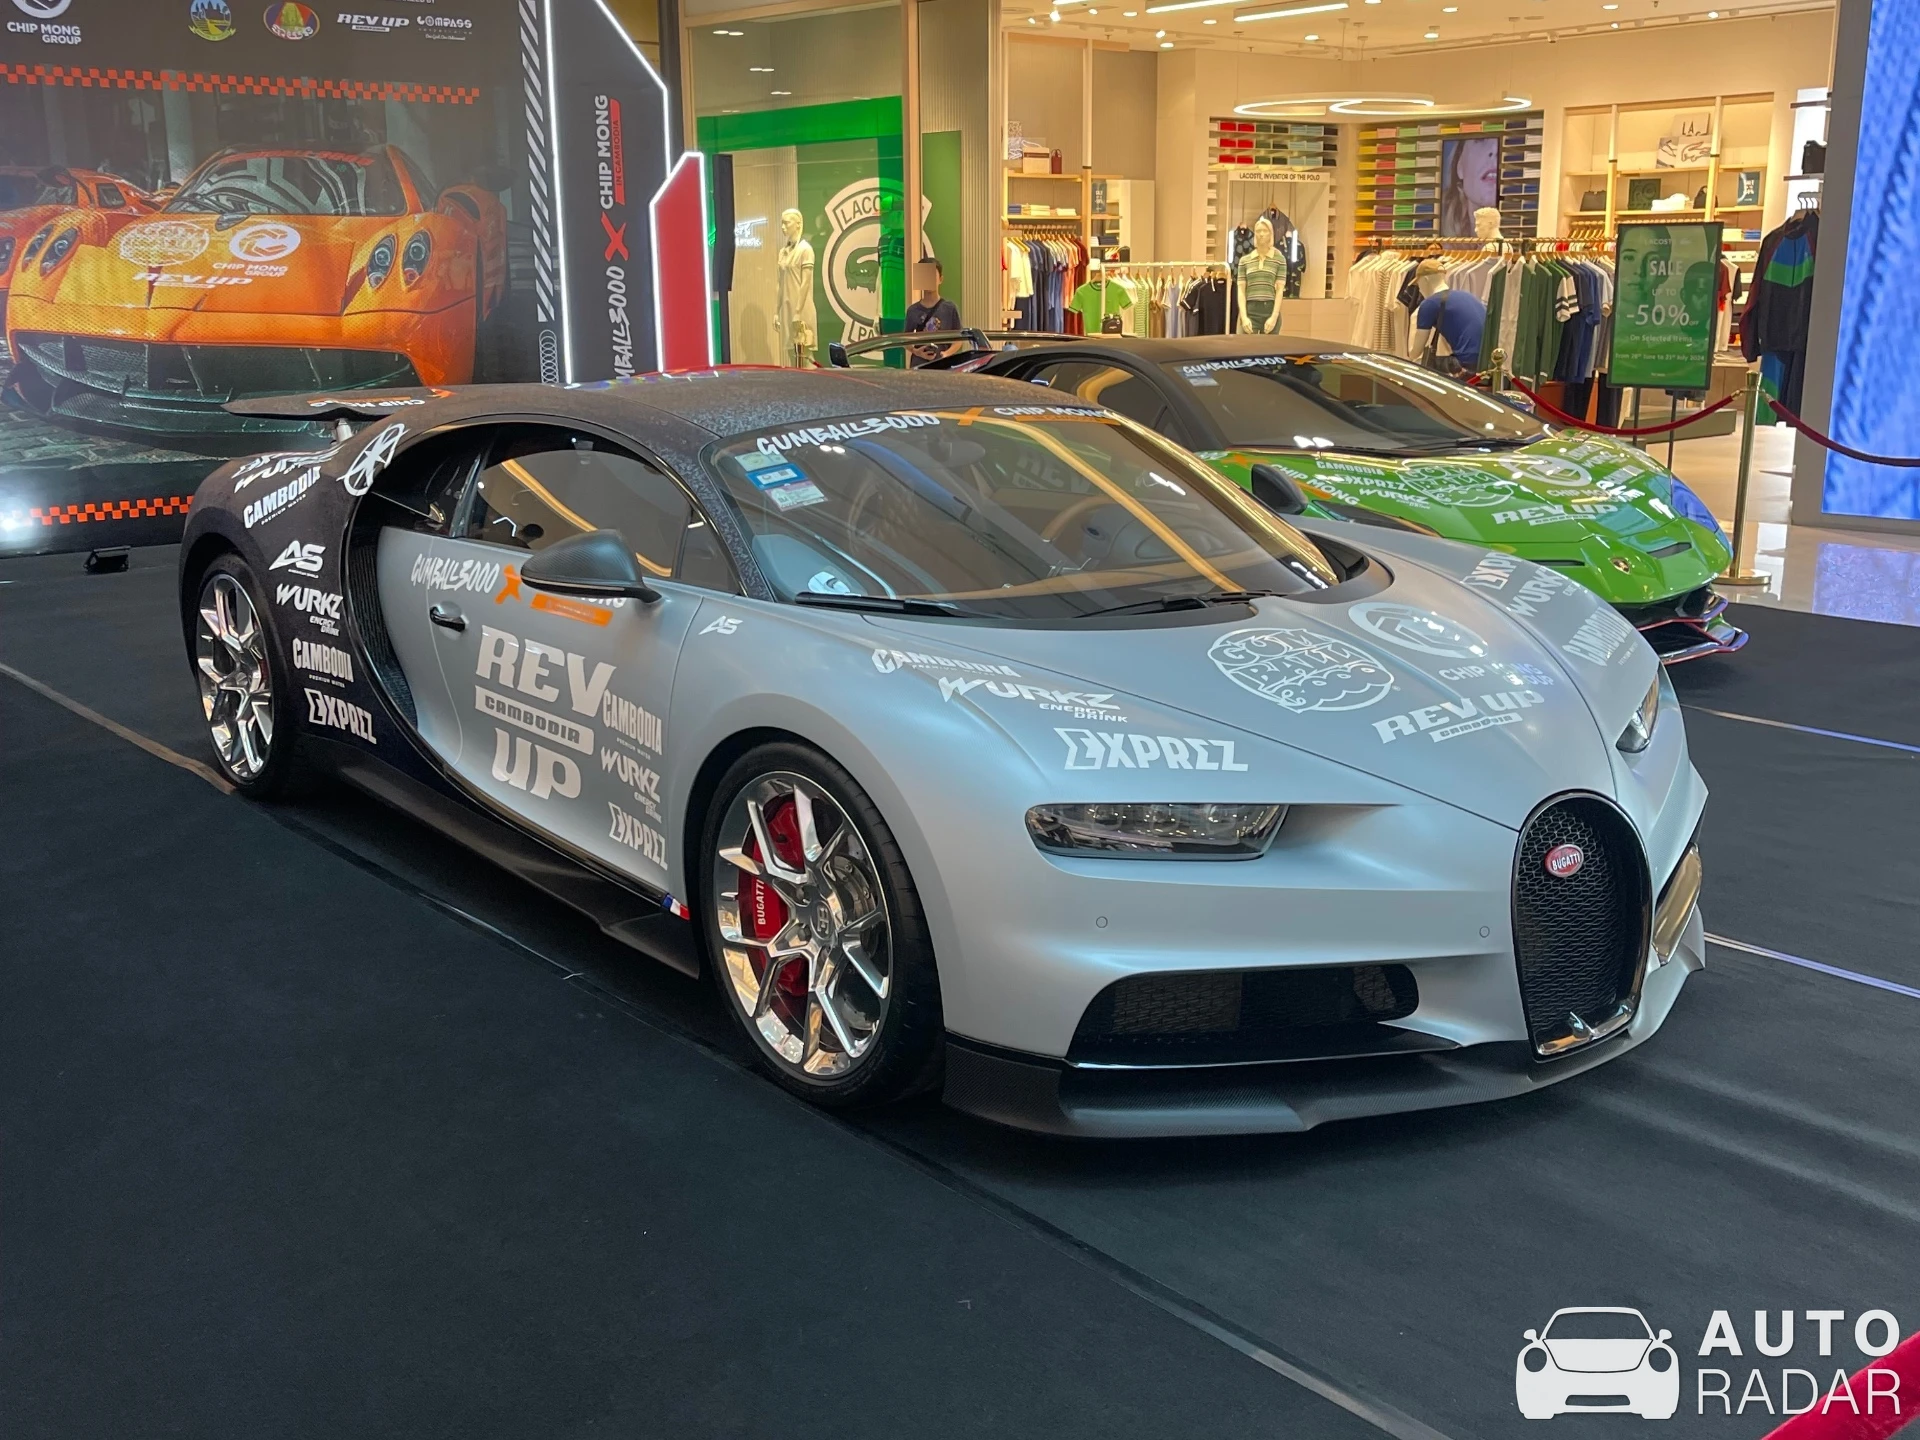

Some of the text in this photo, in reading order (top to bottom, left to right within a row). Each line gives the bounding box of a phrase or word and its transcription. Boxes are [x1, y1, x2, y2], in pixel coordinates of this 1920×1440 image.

[7, 22, 81, 36] CHIP MONG
[42, 34, 82, 45] GROUP
[337, 13, 410, 28] REV UP
[595, 94, 610, 157] MONG
[612, 119, 623, 174] CAMBODIA
[600, 162, 613, 210] CHIP
[840, 194, 882, 225] LACO
[212, 262, 289, 272] CHIP MONG
[1649, 260, 1683, 276] SALE
[606, 266, 635, 380] MBALL3000
[1626, 304, 1690, 326] -50%
[756, 414, 941, 456] GUMBALL3000
[993, 407, 1046, 416] CHIP
[1269, 463, 1361, 506] CHIP MONG
[1316, 460, 1385, 476] CAMBODIA
[243, 465, 322, 529] CAMBODIA
[1491, 504, 1619, 525] REV UP
[276, 583, 344, 620] WURKZ
[1506, 566, 1569, 617] WURK
[293, 637, 354, 683] CAMBODIA
[475, 624, 617, 718] REV
[872, 648, 1023, 675] CAMBODIA
[1438, 664, 1486, 681] CHIP
[938, 676, 1121, 711] WURKZ
[1039, 702, 1108, 715] ENERGY
[484, 694, 581, 745] CAMBODIA
[602, 688, 663, 756] CAMBODIA
[1074, 711, 1128, 723] DRINK
[1372, 689, 1546, 745] REV UP
[1439, 714, 1513, 738] CAMBODIA
[491, 727, 582, 800] UP
[1053, 727, 1249, 772] EXPREZ
[600, 745, 660, 804] WURKZ
[1551, 852, 1581, 871] BUGATTI
[755, 878, 767, 925] BUGATTI
